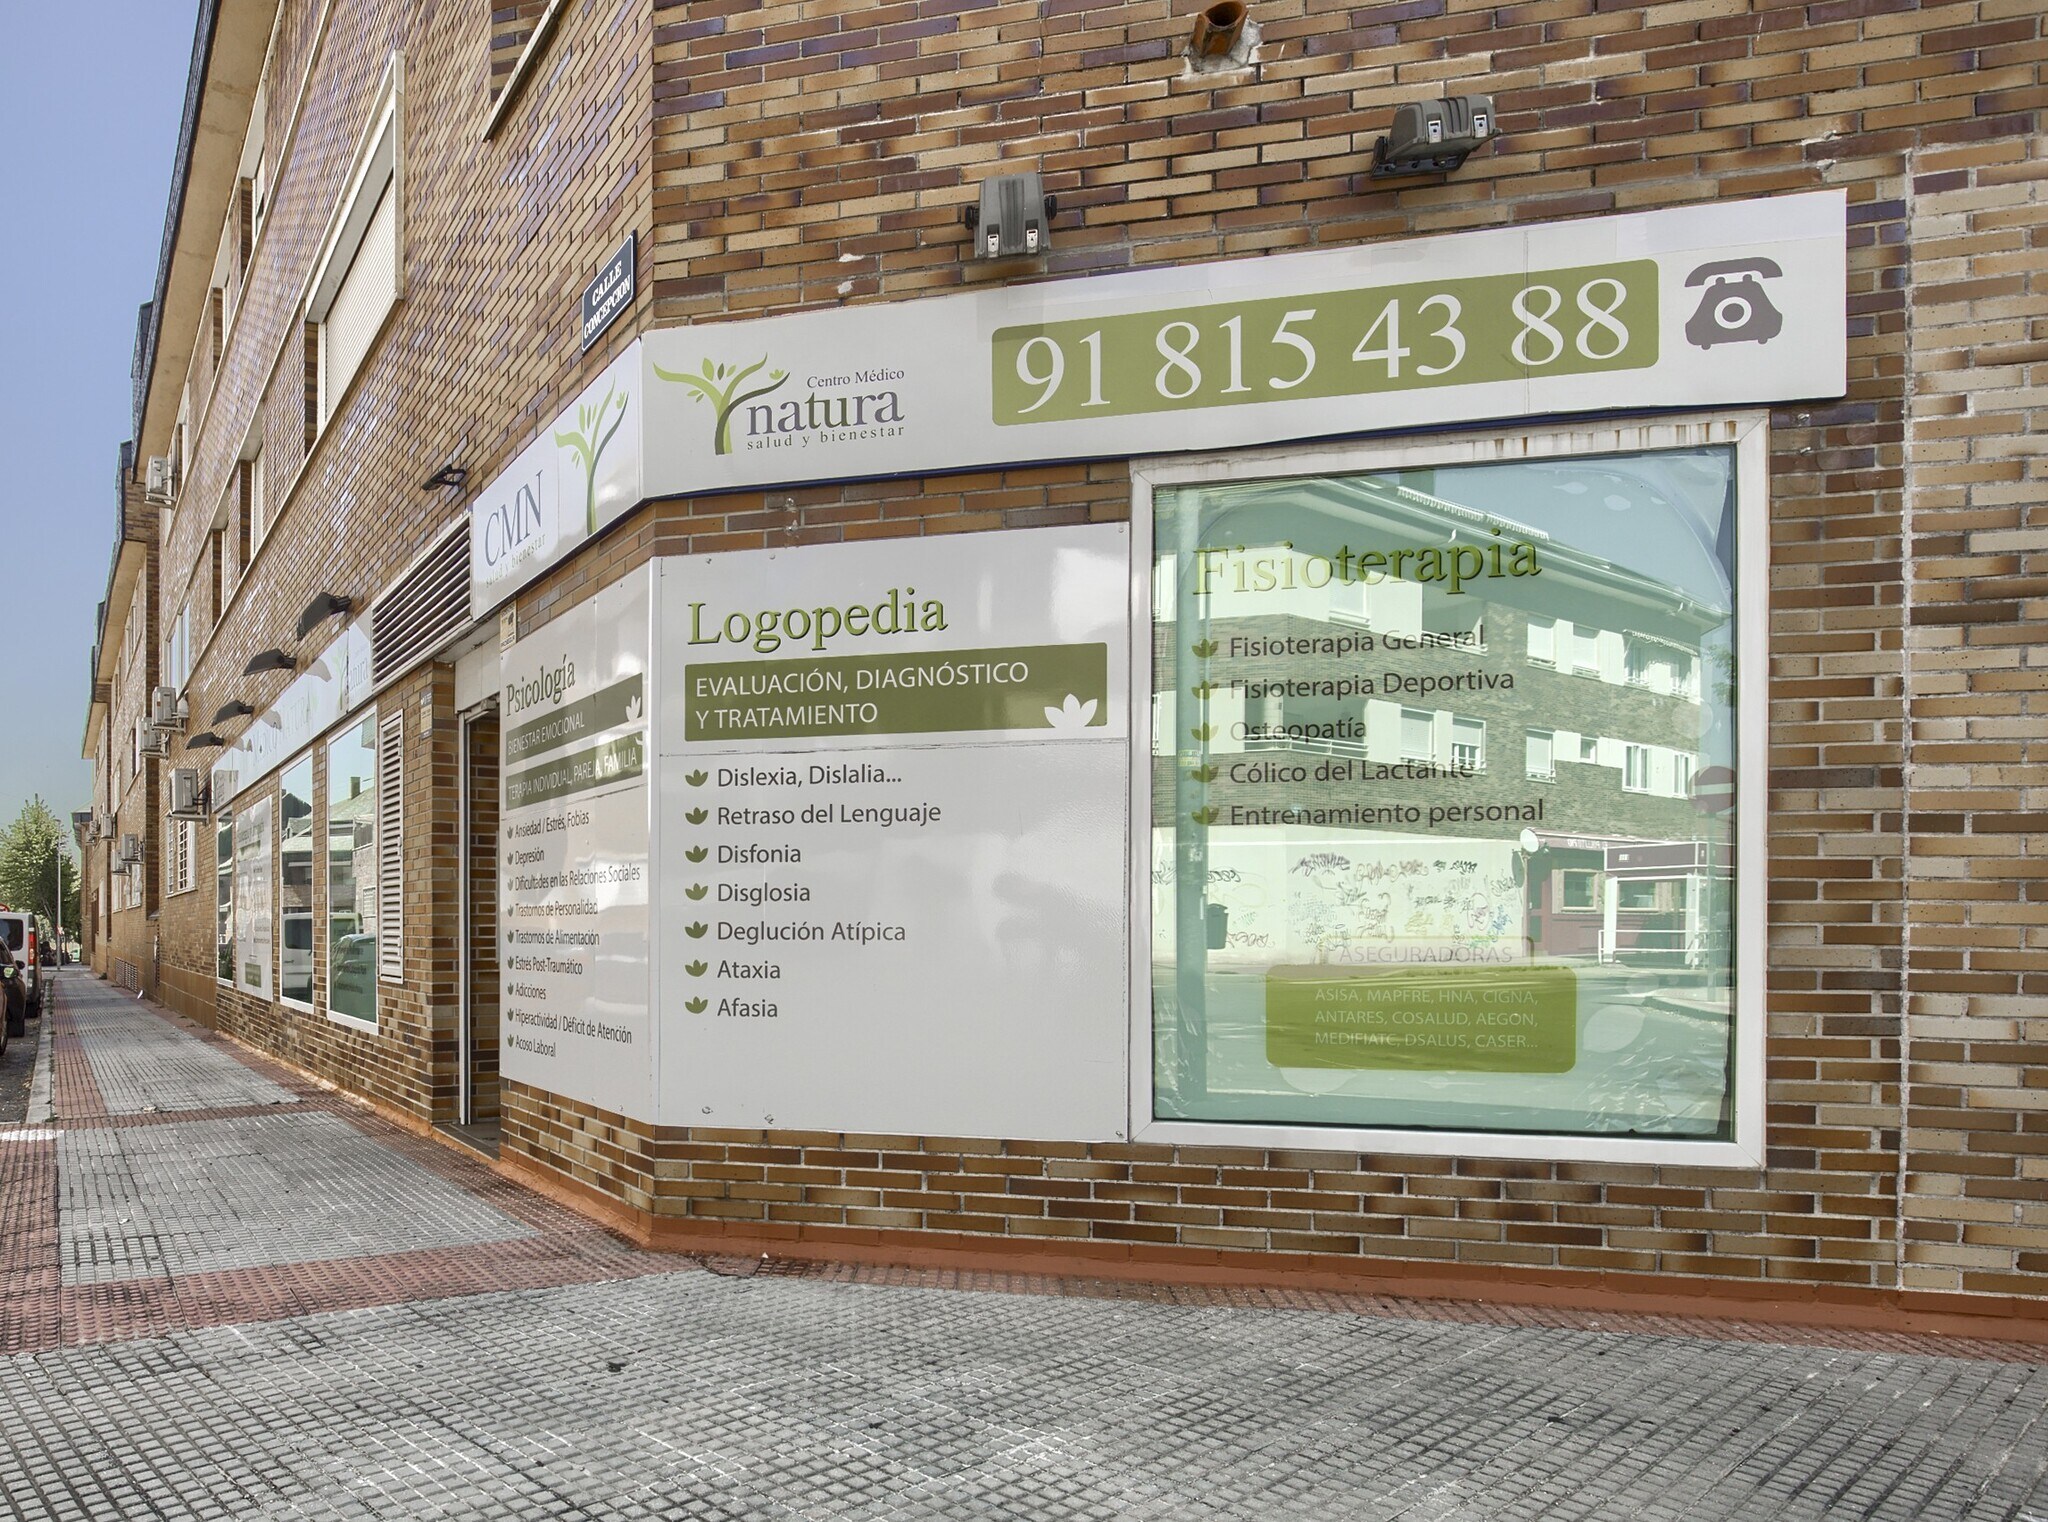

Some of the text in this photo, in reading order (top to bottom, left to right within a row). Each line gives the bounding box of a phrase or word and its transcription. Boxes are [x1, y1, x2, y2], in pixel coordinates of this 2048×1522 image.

[592, 260, 622, 307] CALLE
[584, 274, 631, 339] CONCEPCION
[1015, 278, 1630, 414] 91 815 43 88
[806, 367, 905, 389] Centro Médico
[746, 391, 906, 436] natura
[747, 426, 905, 450] salud y bienestar
[485, 468, 544, 567] CMN
[511, 533, 546, 569] bienestar
[1192, 527, 1543, 595] Fisioterapia
[687, 586, 949, 654] Logopedia
[1230, 624, 1485, 659] Fisioterapia General
[506, 654, 576, 717] Psicología
[696, 661, 1029, 698] EVALUACIÓN, DIAGNÓSTICO
[1230, 668, 1515, 702] Fisioterapia Deportiva
[696, 702, 878, 729] Y TRATAMIENTO
[508, 711, 585, 755] BIENESTAR EMOCIONAL
[1229, 716, 1368, 745] Osteopatía
[508, 747, 637, 800] TERAPIA INDIVIDUAL, PAREJA, FAMILIA
[717, 763, 903, 788] Dislexia, Dislalia...
[1229, 759, 1475, 783] Cólico del Lactante
[514, 808, 590, 838] Ansiedad / Estrés, Fobias
[717, 802, 942, 827] Retraso del Lenguaje
[1230, 799, 1544, 827] Entrenamiento personal
[514, 847, 545, 868] Depresión
[717, 843, 801, 863] Disfonia
[514, 862, 641, 891] Dificultades en las Relaciones Sociales
[717, 882, 811, 907] Disglosia
[515, 898, 599, 918] Trastornos de Personalidad
[515, 929, 600, 946] Trastornos de Alimentación
[717, 920, 906, 946] Deglución Atípica
[515, 956, 583, 975] Estrés Post-Traumático
[1339, 945, 1513, 964] ASEGURADORAS
[717, 959, 781, 979] Ataxia
[515, 982, 547, 1000] Adicciones
[1315, 988, 1539, 1006] ASISA, MAPFRE, HNA, CIGNA,
[717, 997, 778, 1018] Afasia
[1315, 1011, 1538, 1027] ANTARES, COSALUD, AEGON,
[515, 1008, 558, 1031] Hiperactividad
[563, 1016, 586, 1036] Déficit
[586, 1020, 596, 1037] de
[597, 1022, 632, 1044] Atención
[515, 1035, 556, 1058] Acoso Laboral
[1405, 1033, 1470, 1048] DSALUS,
